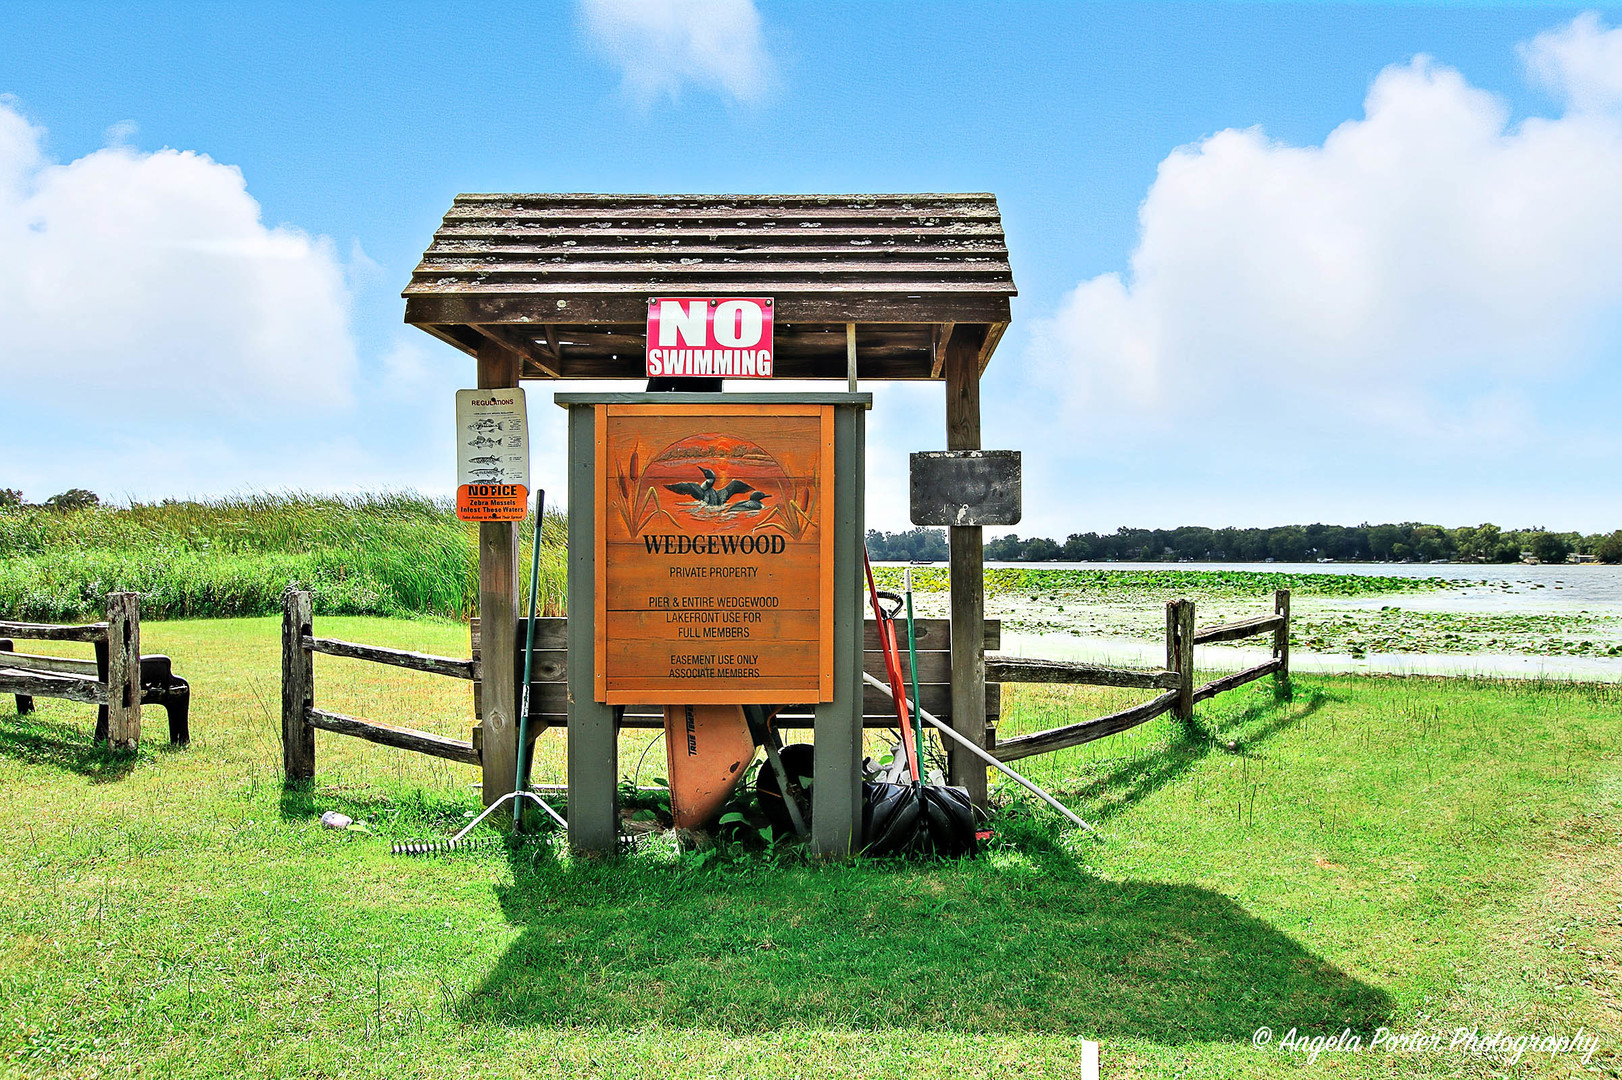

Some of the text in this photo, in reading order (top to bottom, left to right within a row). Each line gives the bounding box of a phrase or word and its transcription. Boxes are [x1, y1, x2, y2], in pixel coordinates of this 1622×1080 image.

[659, 300, 762, 347] NO
[649, 349, 770, 376] SWIMMING
[468, 485, 517, 496] NOTICE
[643, 535, 785, 554] WEDGEWOOD
[670, 567, 758, 577] PRIVATE PROPERTY
[649, 597, 778, 607] PIER & ENTIRE WEDGEWOOD
[667, 612, 761, 622] LAKEFRONT USE FOR
[679, 627, 749, 637] FULL MEMBERS
[671, 655, 758, 665] EASEMENT USE ONLY
[669, 668, 760, 678] ASSOCIATE MEMBERS
[687, 735, 697, 756] TRUE
